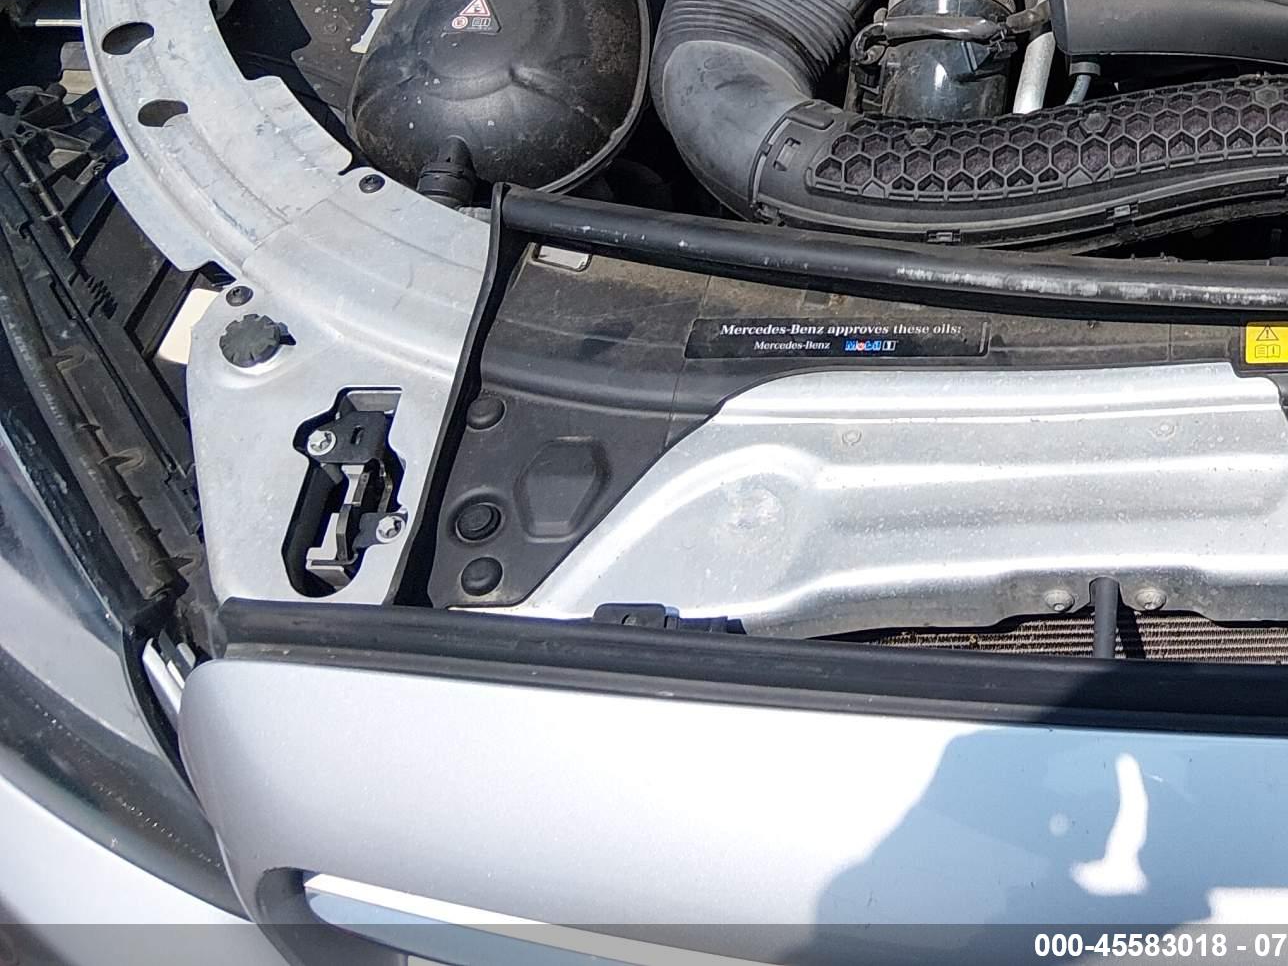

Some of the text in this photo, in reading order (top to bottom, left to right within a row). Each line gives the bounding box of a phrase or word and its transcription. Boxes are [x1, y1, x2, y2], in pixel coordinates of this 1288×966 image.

[721, 324, 962, 337] Mercedes-Benz approves these oils:
[754, 341, 830, 350] Mercedes-Benz
[845, 339, 881, 351] Mobil
